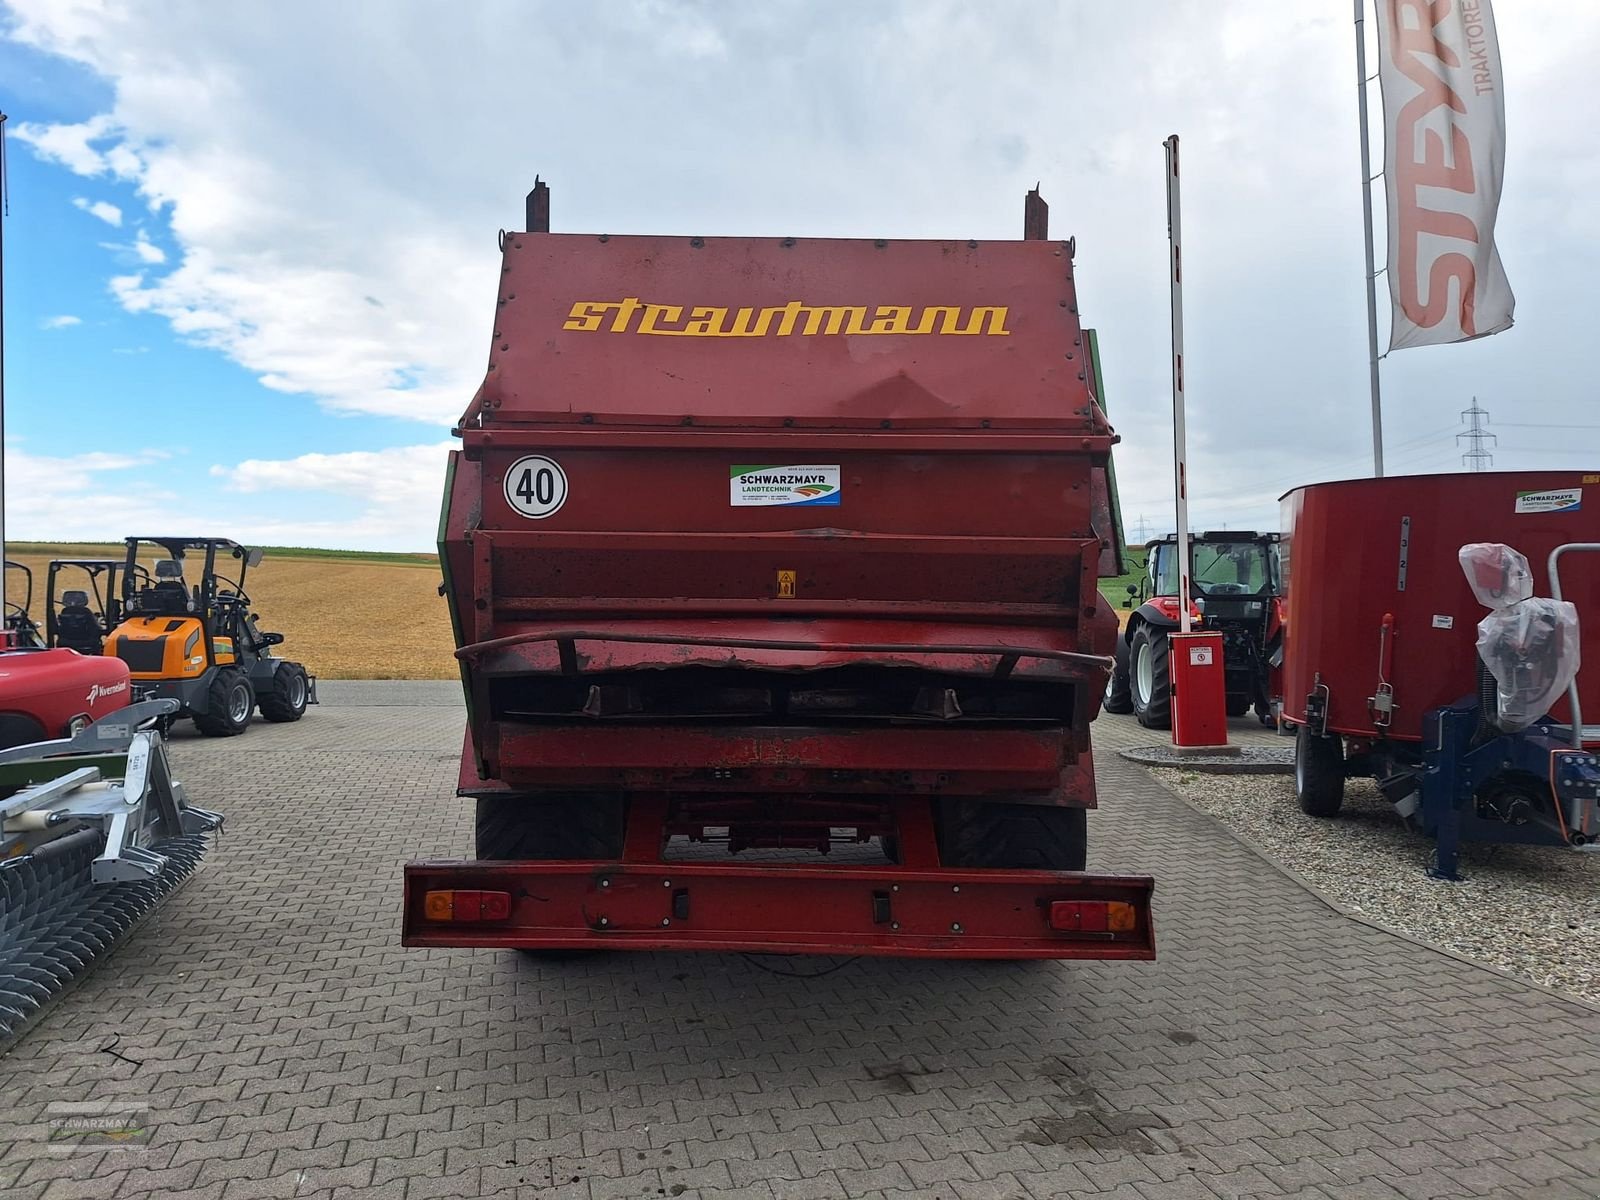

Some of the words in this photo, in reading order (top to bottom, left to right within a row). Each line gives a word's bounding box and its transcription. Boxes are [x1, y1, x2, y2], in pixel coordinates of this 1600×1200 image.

[562, 297, 1011, 337] strautmann
[740, 475, 826, 485] SCHWARZMAYR
[516, 468, 554, 505] 40
[1521, 494, 1574, 502] SCHWARZMAYR
[1403, 518, 1409, 526] 4
[1401, 539, 1407, 547] 3
[1400, 560, 1406, 568] 2
[1399, 581, 1404, 589] 1
